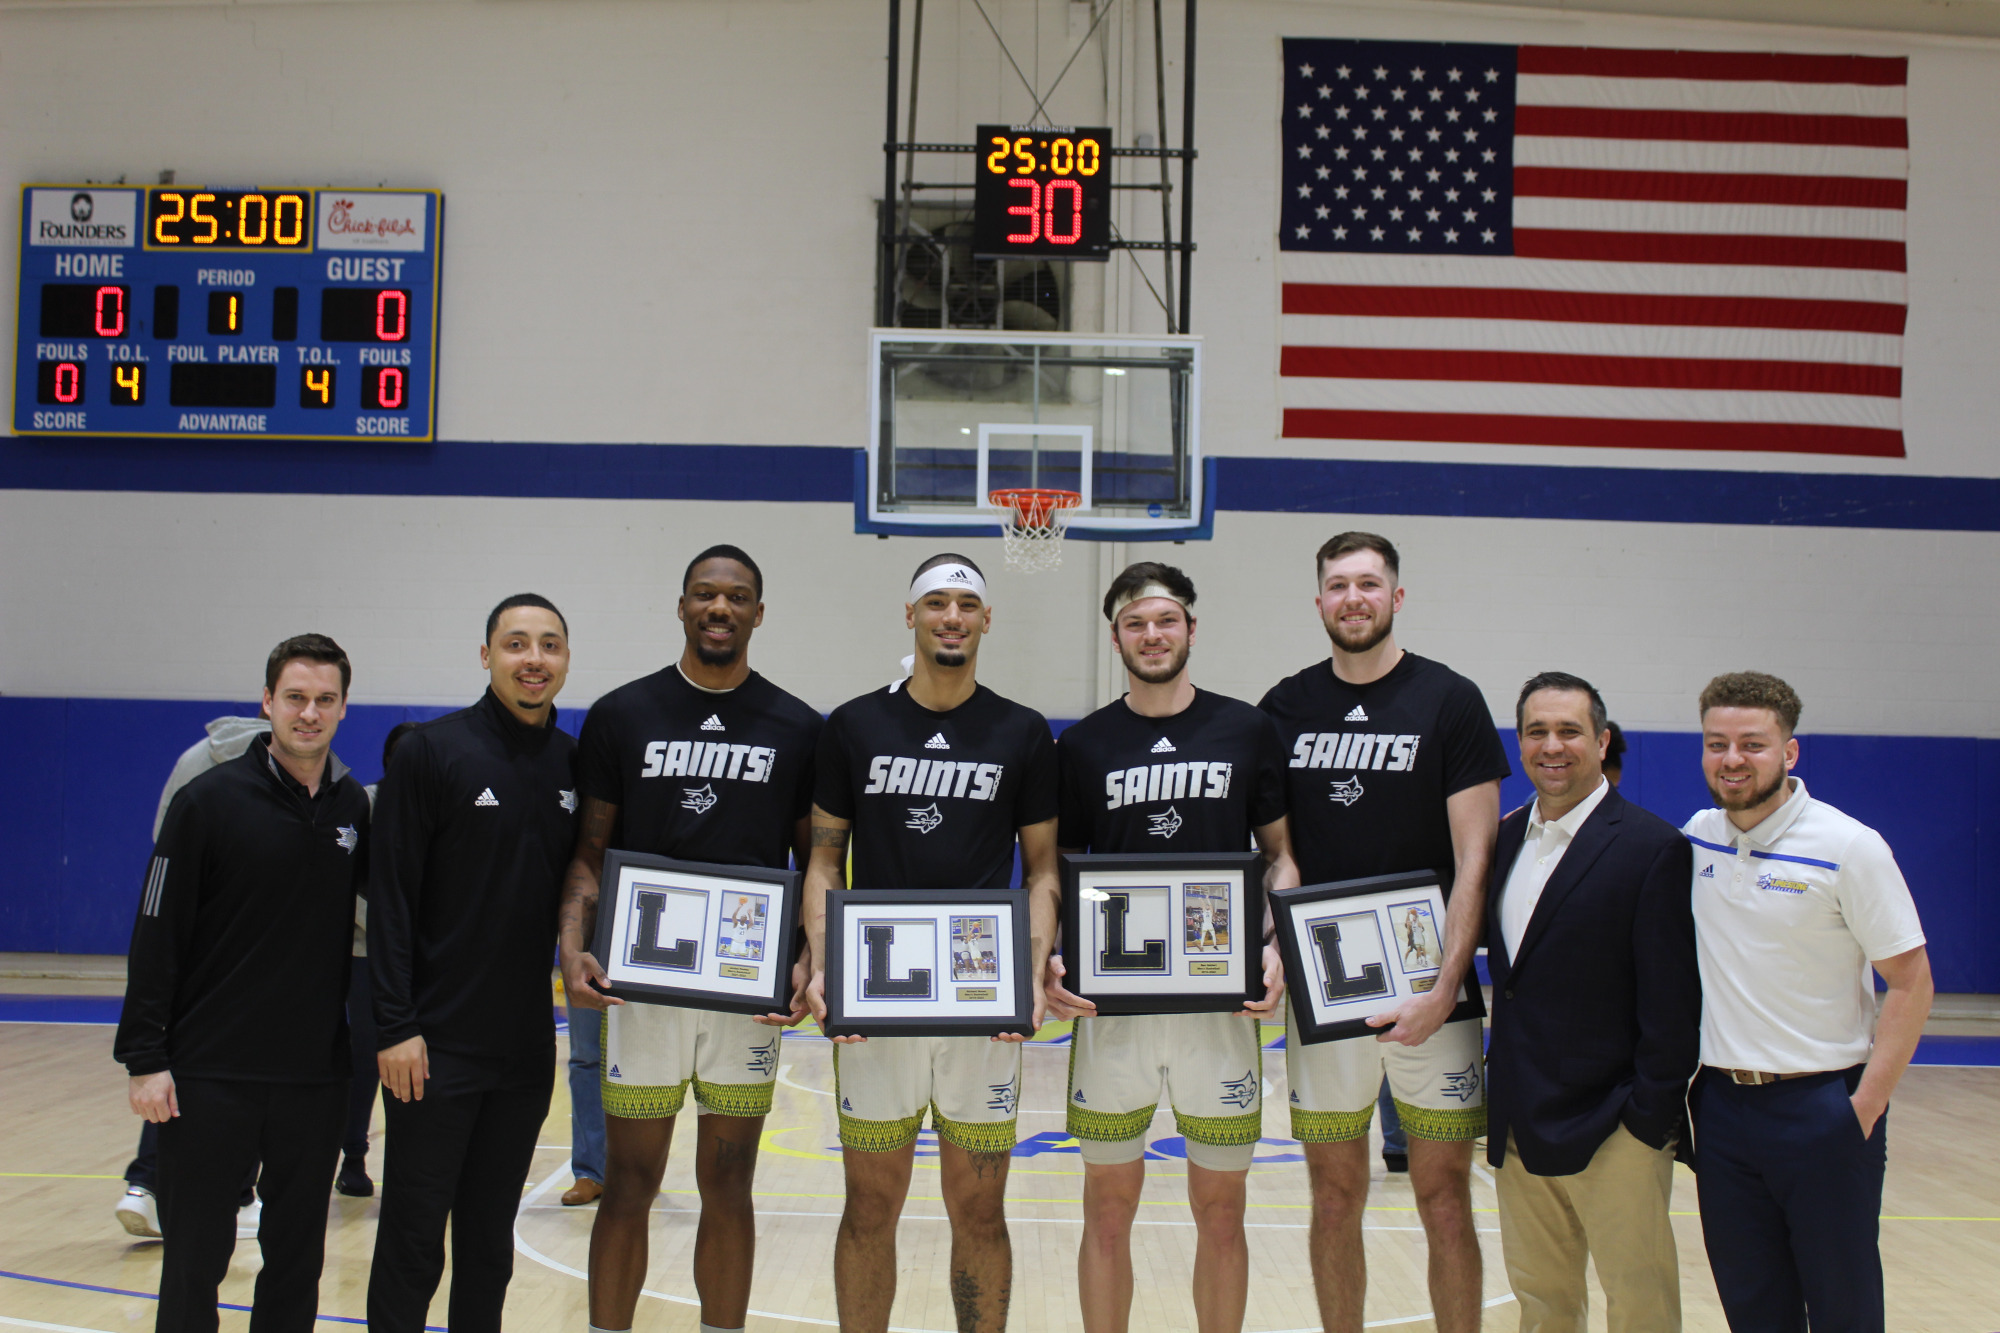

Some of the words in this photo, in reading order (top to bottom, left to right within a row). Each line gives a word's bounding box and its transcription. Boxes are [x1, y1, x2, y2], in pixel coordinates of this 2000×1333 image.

[987, 137, 1099, 176] 25:00
[155, 193, 303, 245] 25:00
[1007, 178, 1082, 244] 30
[40, 221, 126, 239] FOUNDERS
[56, 253, 124, 277] HOME
[198, 269, 255, 286] PERIOD
[327, 257, 405, 281] GUEST
[95, 286, 124, 336] 0
[229, 296, 237, 330] 1
[376, 290, 406, 341] 0
[37, 344, 88, 361] FOULS
[106, 345, 150, 361] T.O.L.
[168, 345, 208, 362] FOUL
[218, 345, 279, 363] PLAYER
[298, 347, 341, 364] T.O.L.
[359, 348, 411, 365] FOULS
[54, 363, 79, 403] 0
[116, 366, 139, 401] 4
[306, 370, 329, 404] 4
[378, 367, 403, 408] 0
[33, 412, 87, 430] SCORE
[178, 414, 267, 432] ADVANTAGE
[356, 417, 410, 435] SCORE
[946, 577, 973, 586] adidas
[700, 723, 726, 732] adidas
[641, 740, 771, 783] SAINTS
[924, 741, 950, 750] adidas
[1288, 732, 1415, 772] SAINTS
[864, 755, 998, 801] SAINTS
[1106, 761, 1227, 811] SAINTS
[474, 799, 500, 807] adidas
[630, 890, 698, 970] L
[1100, 892, 1166, 971] L
[864, 925, 932, 998] L
[1310, 922, 1388, 1001] L
